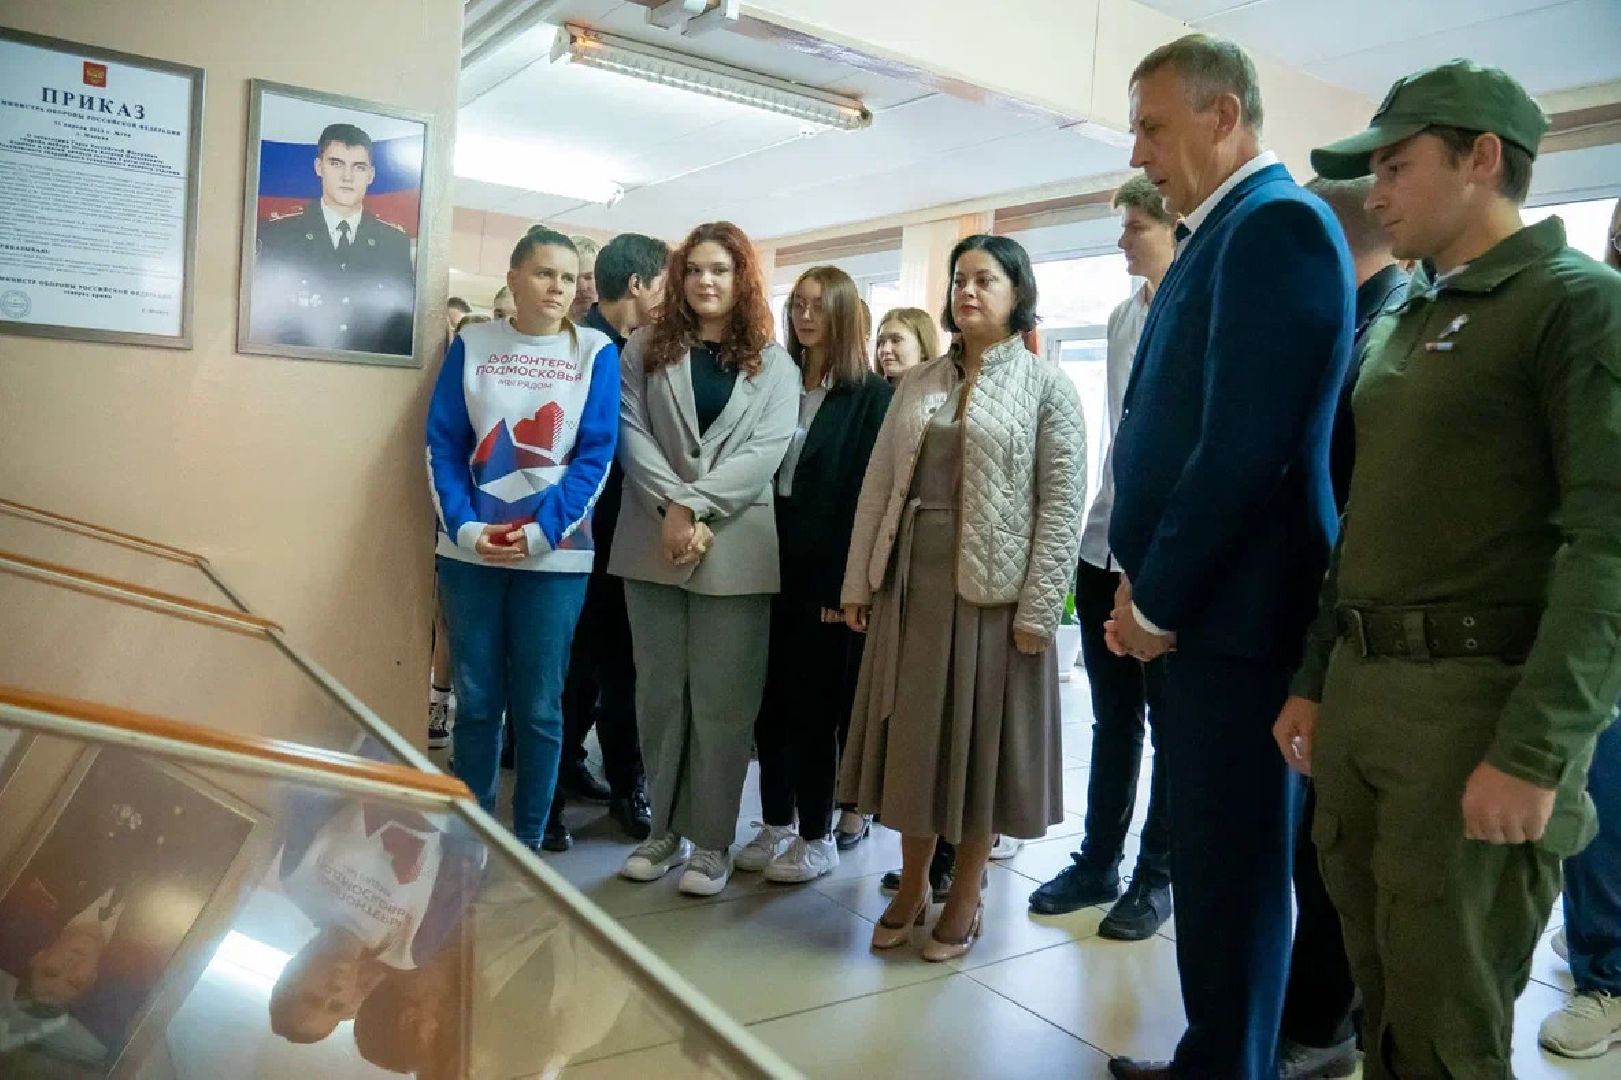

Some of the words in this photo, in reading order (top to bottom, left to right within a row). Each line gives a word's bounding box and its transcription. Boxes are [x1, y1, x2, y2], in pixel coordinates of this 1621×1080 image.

[41, 87, 146, 120] ПРИКАЗ
[487, 353, 577, 370] ВОЛОНТЕРЫ
[475, 364, 583, 382] ПОДМОСКОВЬЯ
